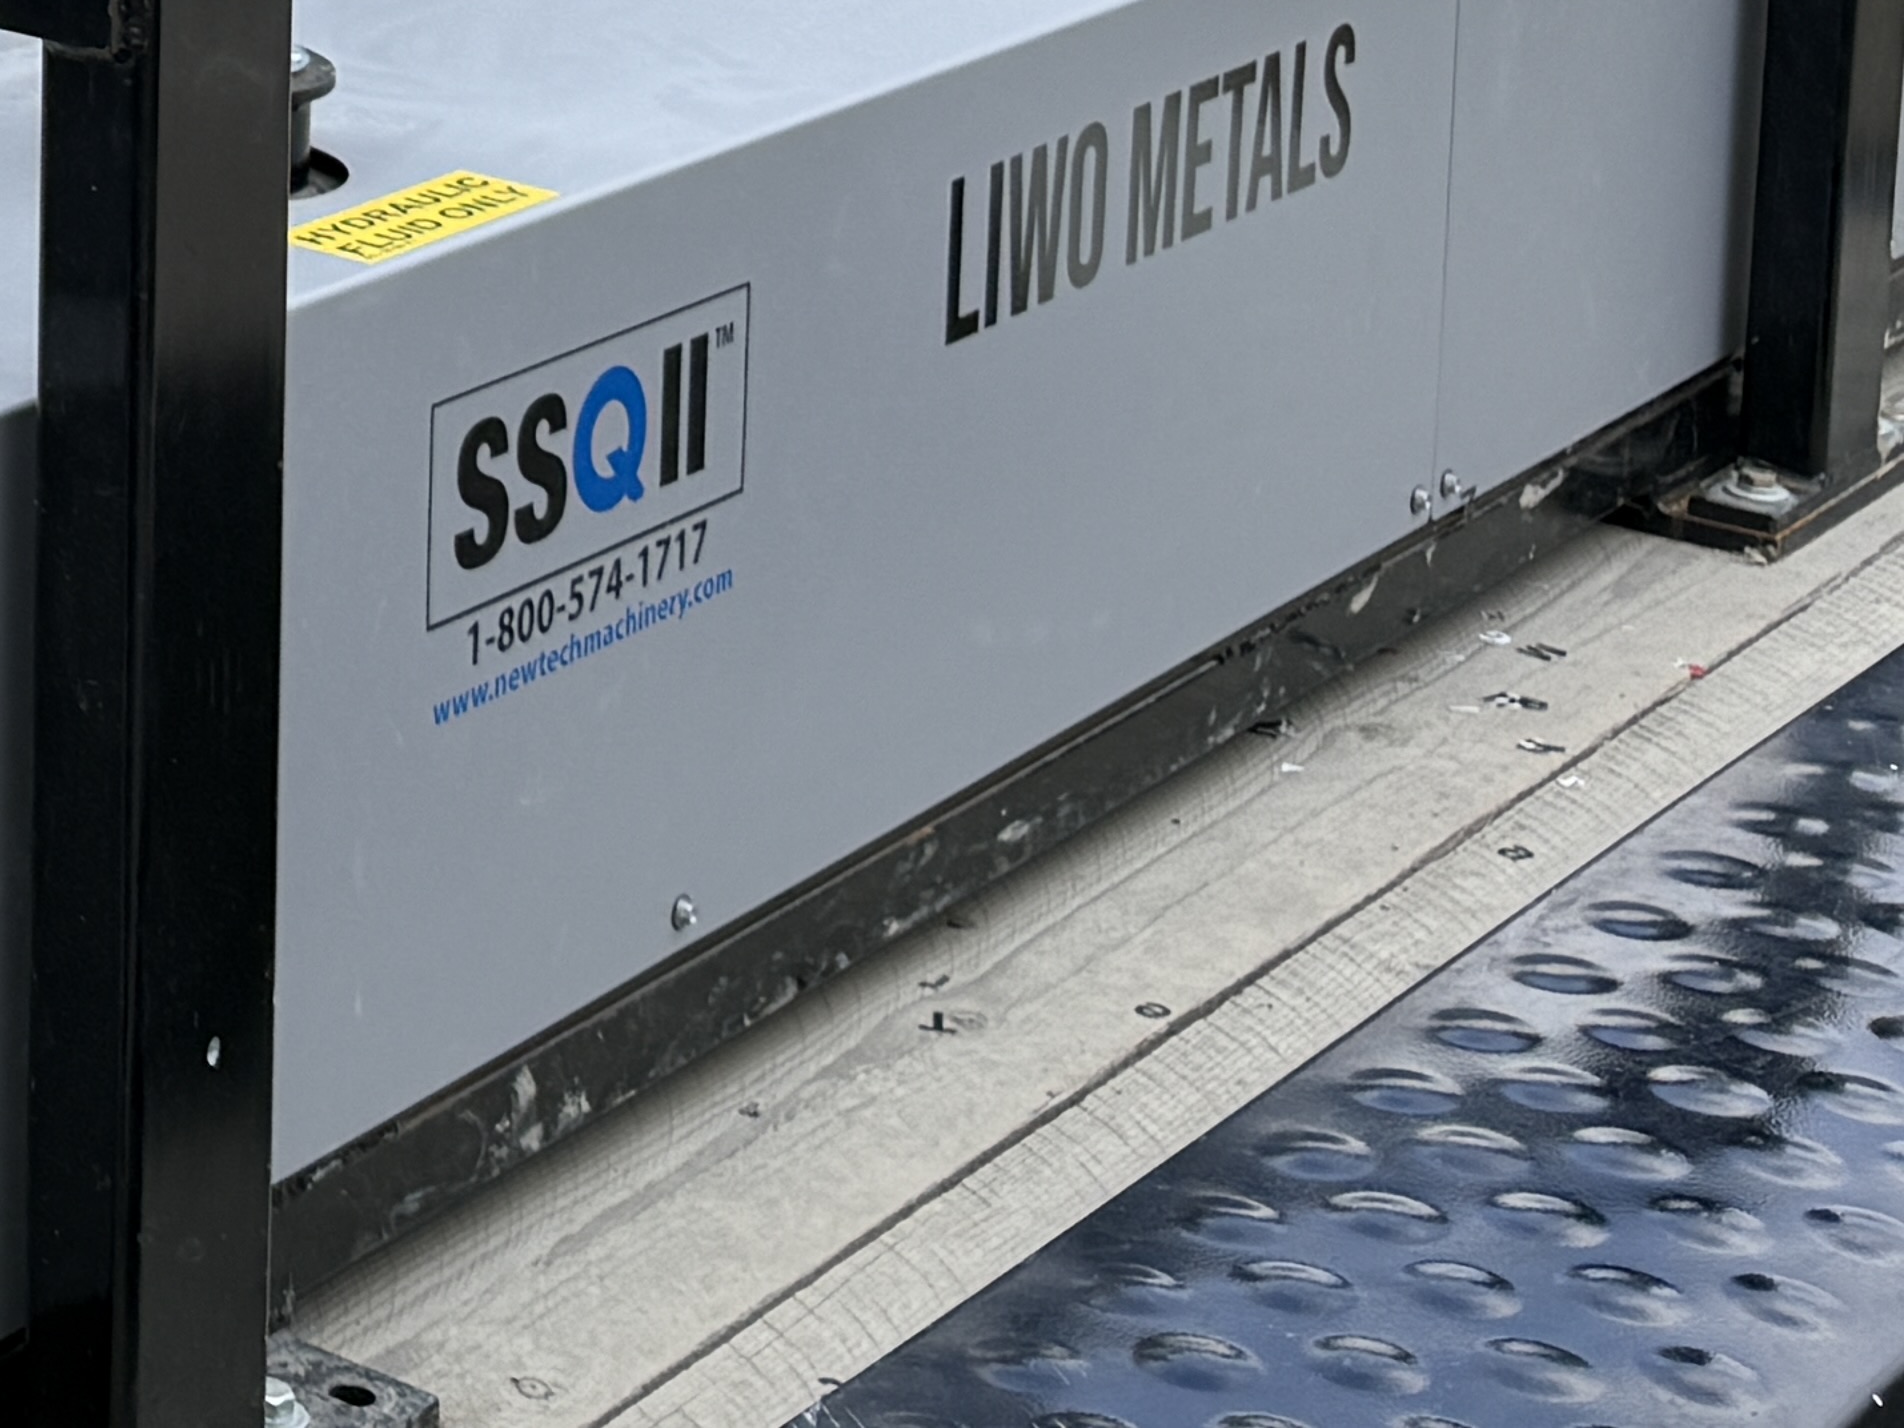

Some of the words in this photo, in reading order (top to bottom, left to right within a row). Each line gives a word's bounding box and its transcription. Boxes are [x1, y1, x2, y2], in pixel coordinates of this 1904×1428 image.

[295, 176, 489, 245] HYDRAULIC
[336, 218, 443, 258] FLUID
[439, 186, 530, 220] ONLY
[945, 121, 1109, 345] LIWO
[1125, 22, 1356, 266] METALS
[433, 568, 733, 726] www.newtechmachinery.com
[467, 519, 708, 665] 1-800-574-1717
